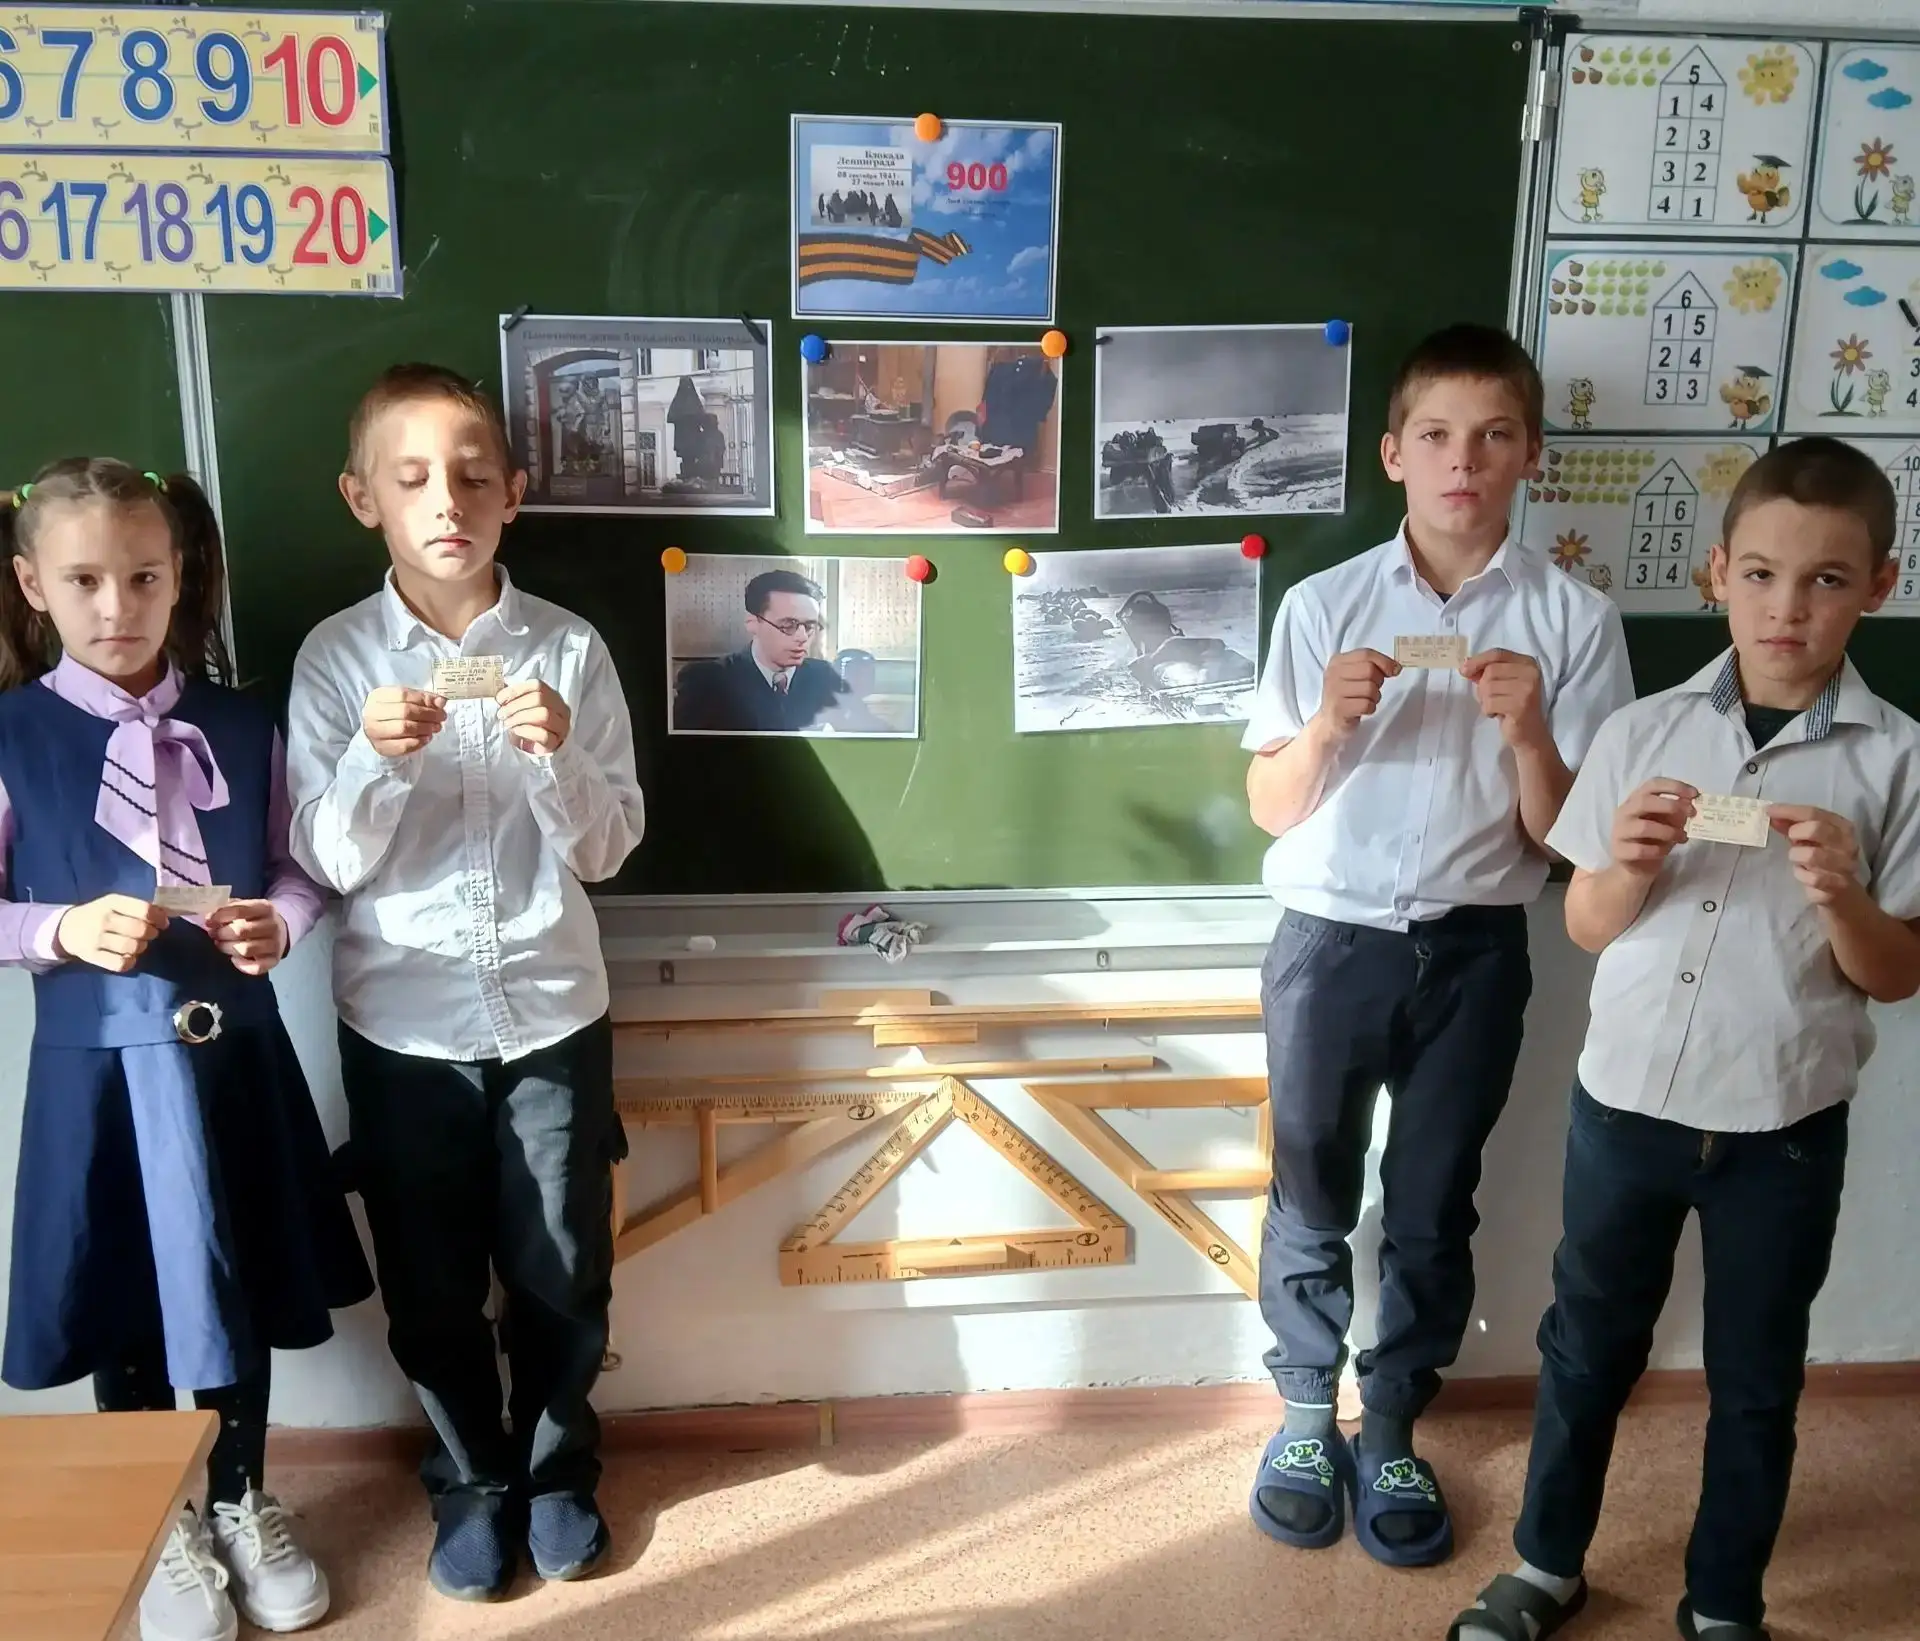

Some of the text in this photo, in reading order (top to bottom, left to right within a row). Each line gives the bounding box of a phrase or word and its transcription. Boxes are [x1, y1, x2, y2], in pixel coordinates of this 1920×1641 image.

[15, 13, 262, 31] +1 +1 +1 +1
[41, 29, 95, 119] 7
[121, 30, 175, 121] 8
[196, 31, 252, 124] 9
[263, 33, 357, 126] 10
[1689, 64, 1700, 84] 5
[1670, 93, 1714, 116] 1 4
[1665, 126, 1711, 150] 2 3
[23, 159, 283, 175] +1 +1 +1 +1
[946, 161, 1008, 191] 900
[1662, 161, 1707, 182] 3 2
[1656, 195, 1702, 218] 4 1
[41, 181, 108, 261] 17
[124, 182, 194, 263] 18
[205, 184, 275, 264] 19
[288, 185, 367, 266] 20
[1681, 290, 1692, 309] 6
[1664, 313, 1706, 336] 1 5
[1658, 347, 1702, 368] 2 4
[1655, 378, 1698, 400] 3 3
[1906, 387, 1918, 408] 4
[1664, 477, 1675, 496] 7
[1645, 500, 1686, 522] 1 6
[1639, 531, 1683, 553] 2 5
[1636, 562, 1678, 583] 3 4
[1907, 554, 1917, 570] 6
[1904, 579, 1913, 595] 5
